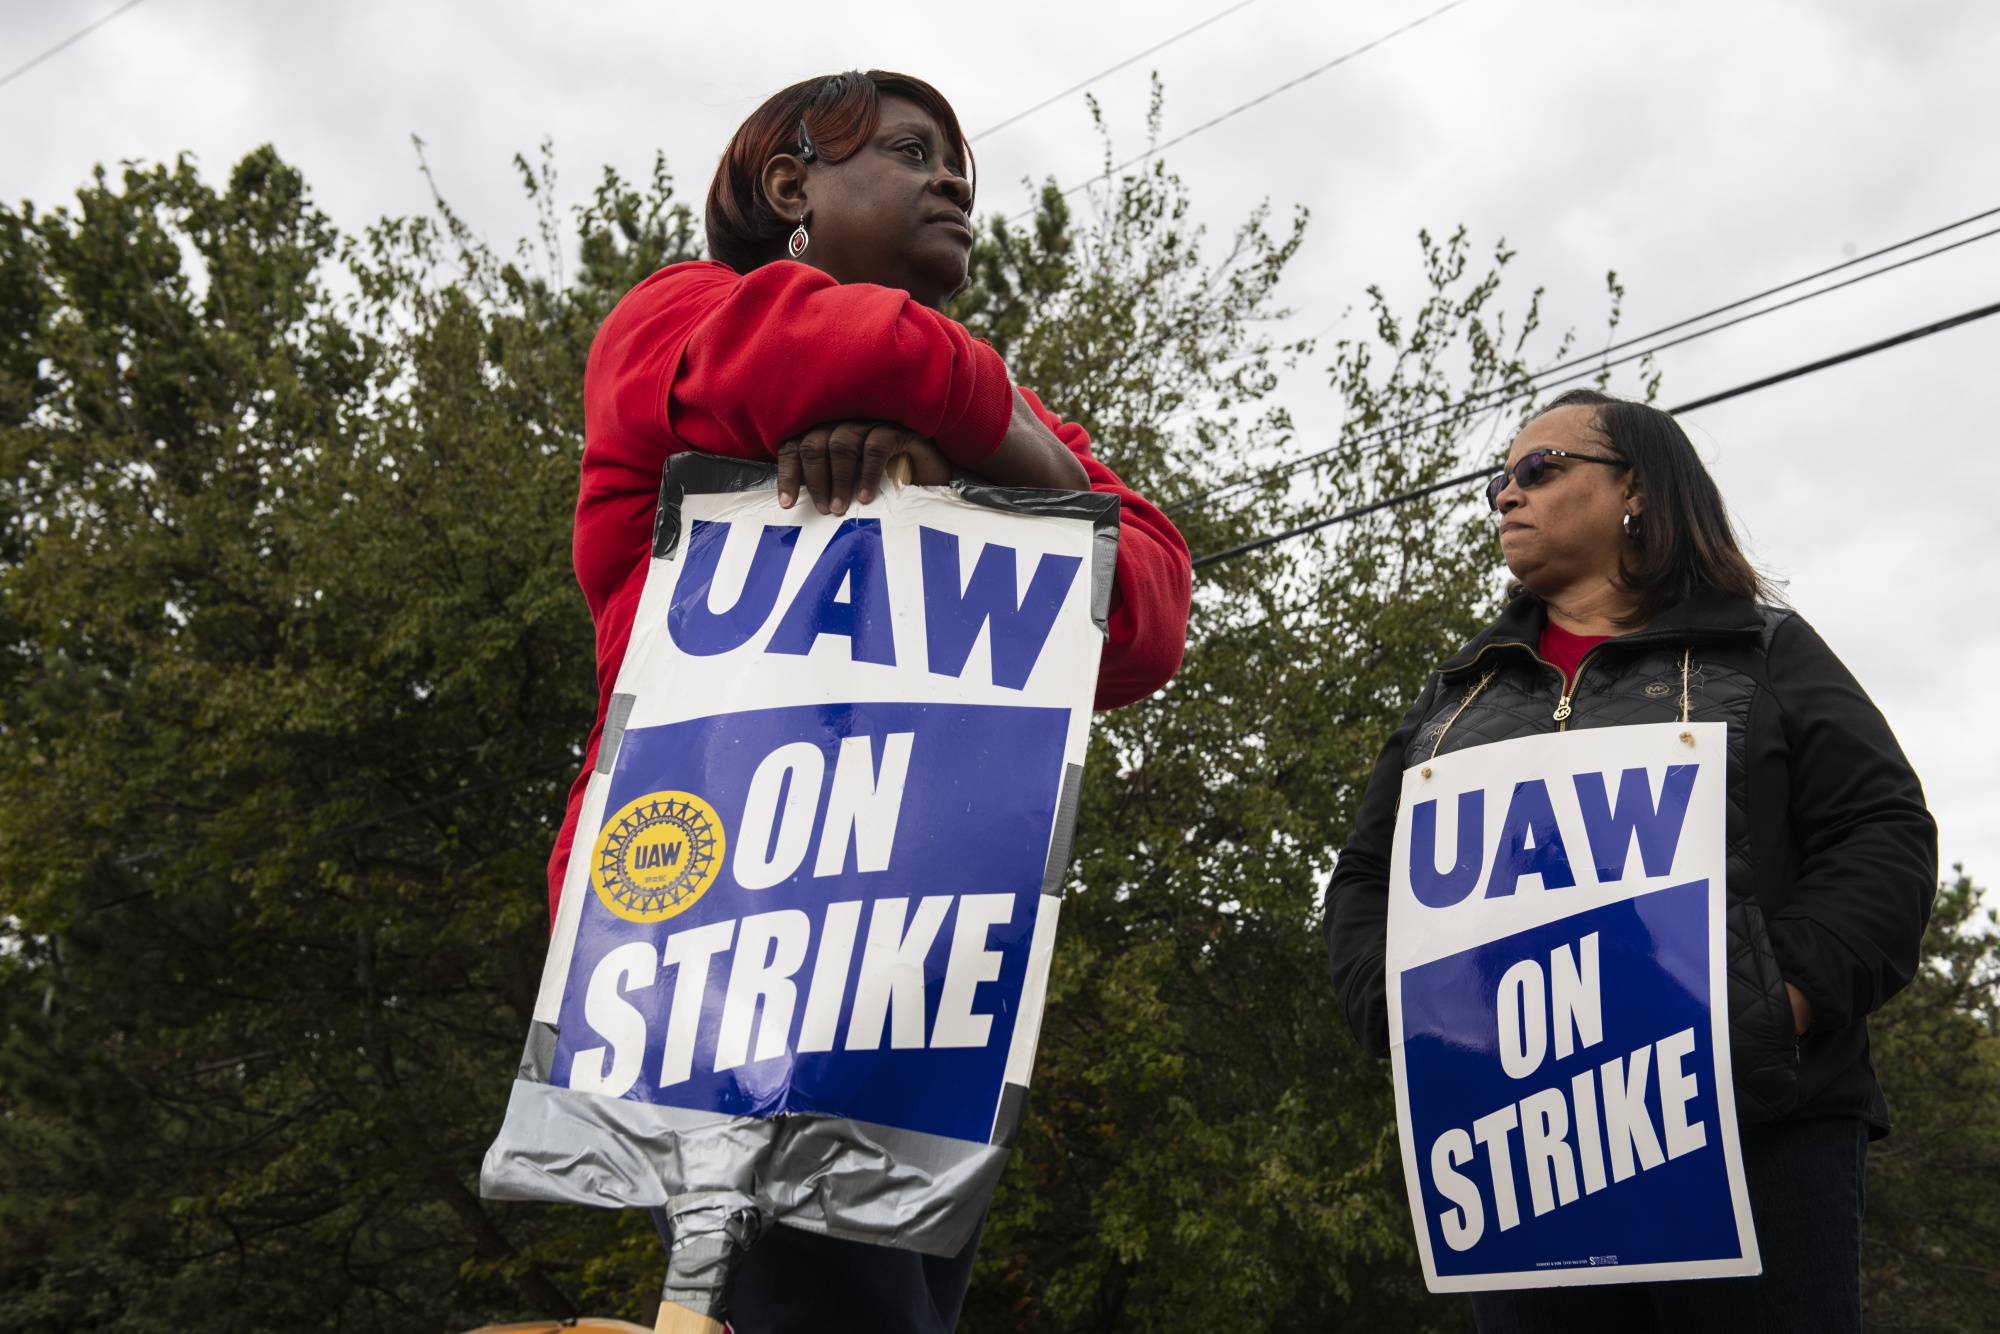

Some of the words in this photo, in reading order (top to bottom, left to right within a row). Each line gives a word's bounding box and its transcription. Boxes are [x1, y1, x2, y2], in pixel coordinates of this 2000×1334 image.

[666, 517, 1082, 691] UAW
[618, 830, 636, 859] AEROSPACE
[634, 821, 646, 831] AND
[646, 816, 683, 825] AGRICULTURAL
[681, 822, 697, 848] IMPLEMENT
[634, 841, 683, 870] UAW
[731, 732, 915, 891] ON
[1409, 764, 1700, 909] UAW
[569, 893, 1015, 1099] STRIKE
[1496, 931, 1603, 1079] ON
[1431, 1027, 1707, 1252] STRIKE
